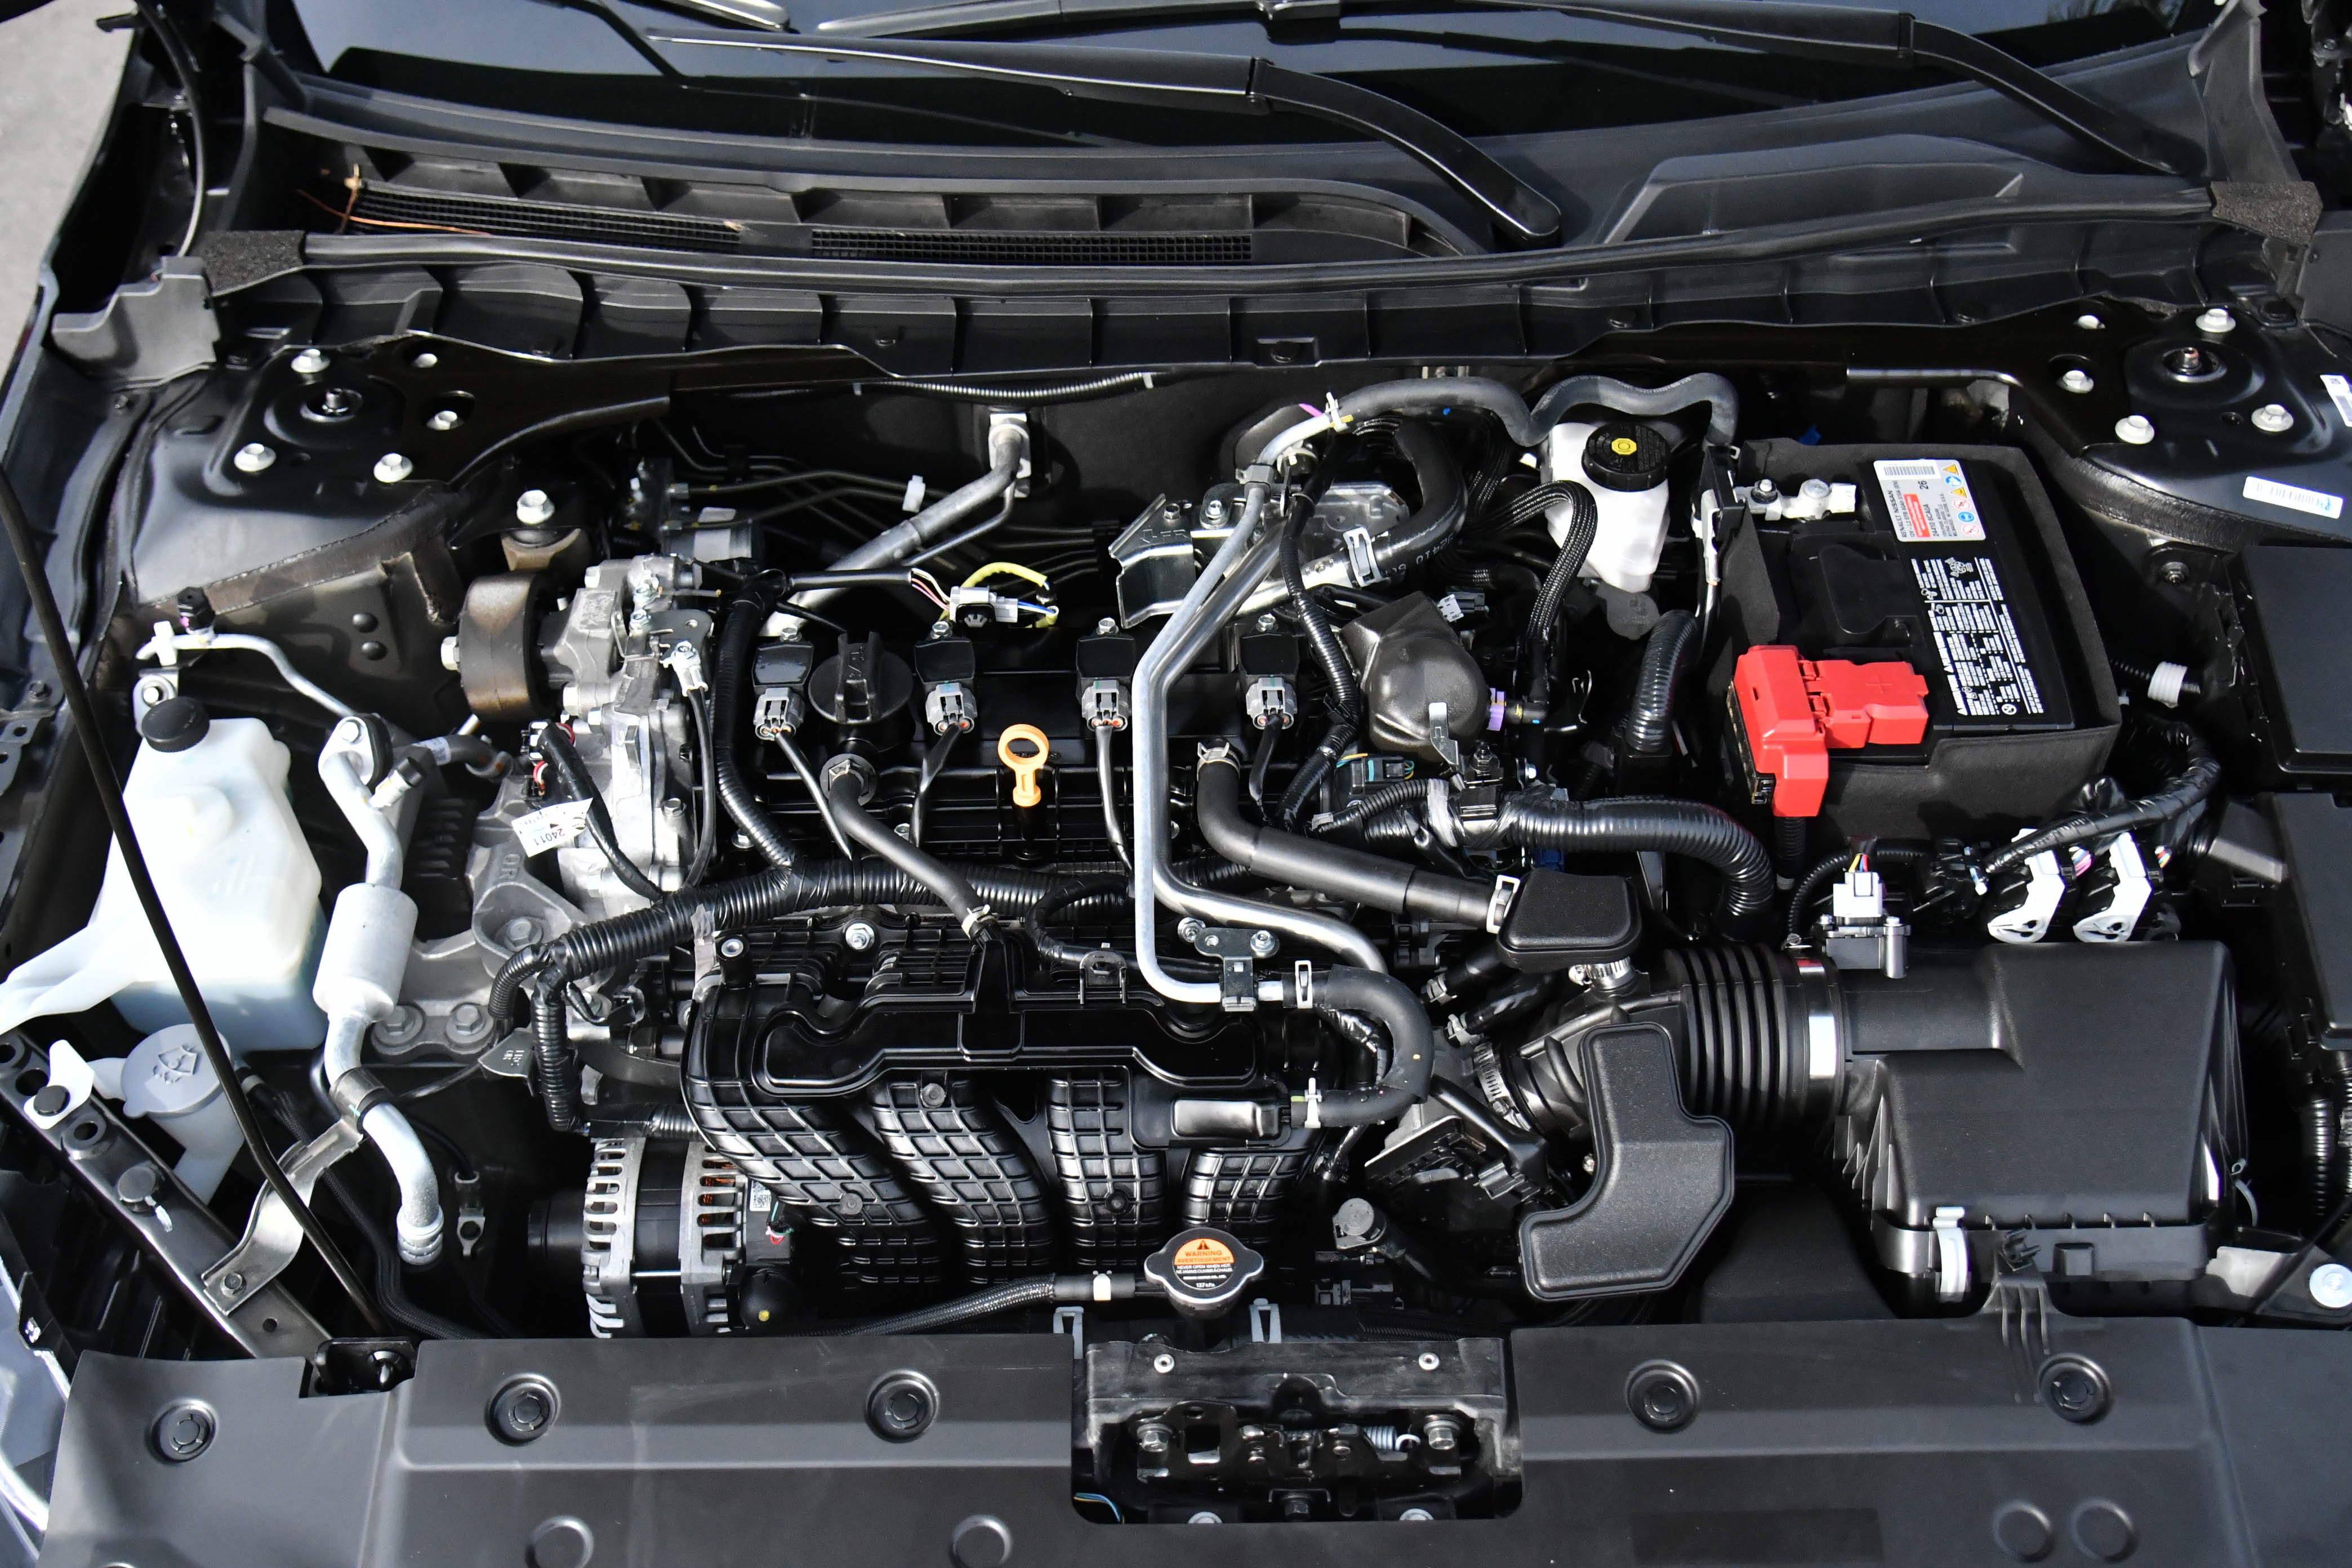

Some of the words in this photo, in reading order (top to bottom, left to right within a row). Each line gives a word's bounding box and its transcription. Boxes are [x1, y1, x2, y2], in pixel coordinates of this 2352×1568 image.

[1918, 480, 1929, 490] 26
[1887, 489, 1899, 513] NISSAN
[1895, 515, 1907, 538] RENAULT
[534, 828, 565, 846] 24011
